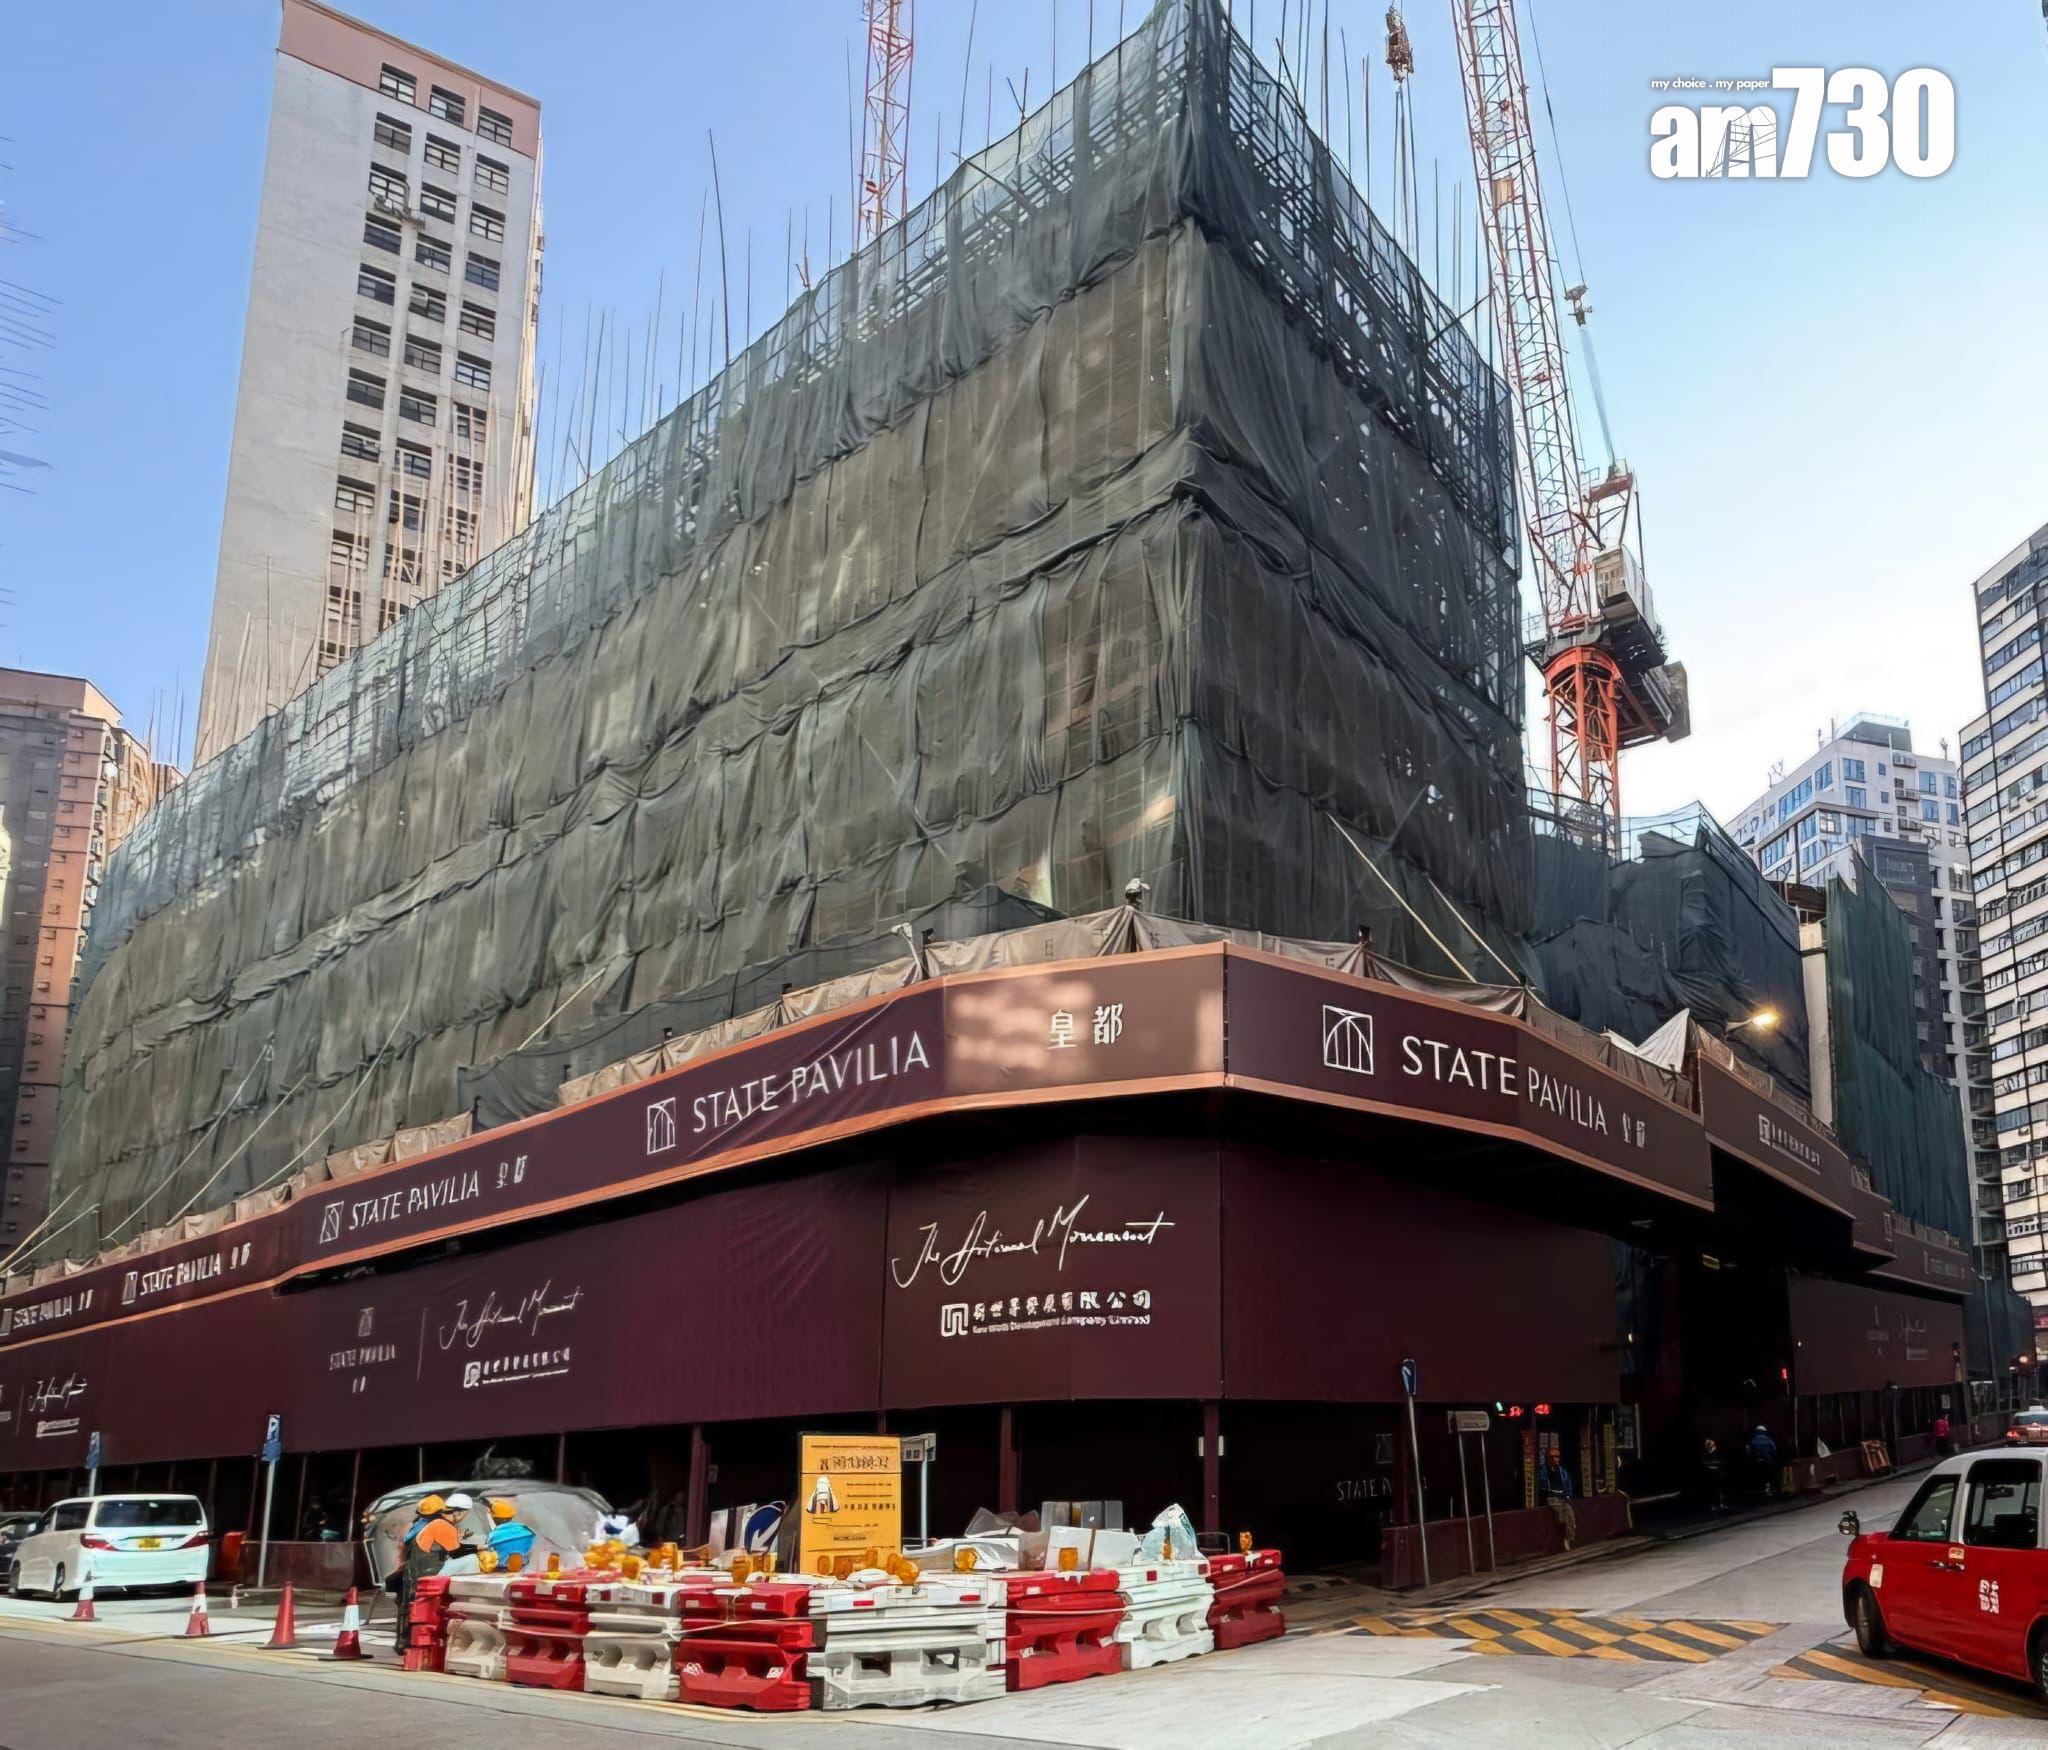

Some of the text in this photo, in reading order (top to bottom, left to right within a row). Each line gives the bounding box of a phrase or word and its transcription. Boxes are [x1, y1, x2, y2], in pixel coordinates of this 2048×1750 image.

[693, 1003, 1123, 1133] STATE PAVILIA 皇都
[1402, 1035, 1519, 1096] STATE
[1528, 1066, 1608, 1136] PAVILIA
[348, 1191, 403, 1231] STATE
[407, 1170, 480, 1214] PAVILIA
